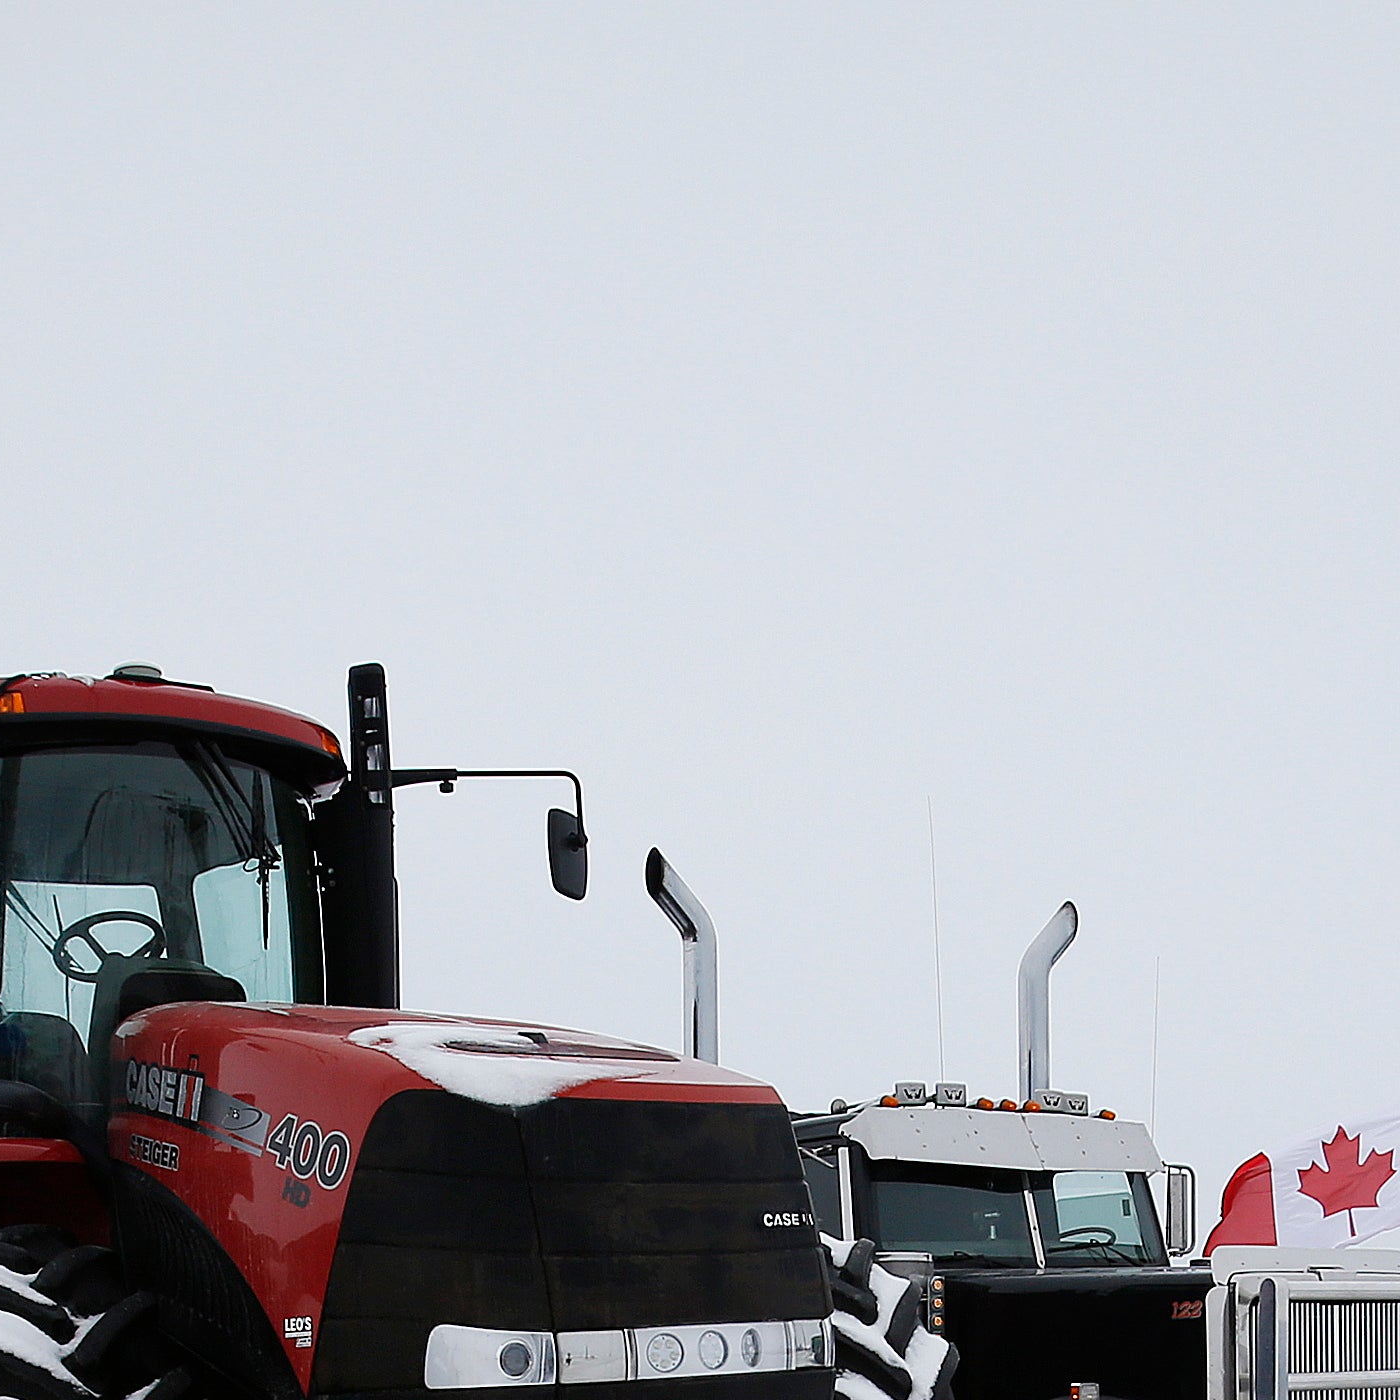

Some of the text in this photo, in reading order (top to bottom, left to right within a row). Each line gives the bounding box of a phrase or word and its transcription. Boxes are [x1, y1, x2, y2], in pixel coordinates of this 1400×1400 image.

[130, 1133, 180, 1172] STEIGER
[266, 1112, 351, 1191] 400
[282, 1176, 311, 1209] HD
[763, 1212, 800, 1228] CASE
[1171, 1300, 1204, 1319] 122
[284, 1316, 312, 1332] LEO'S
